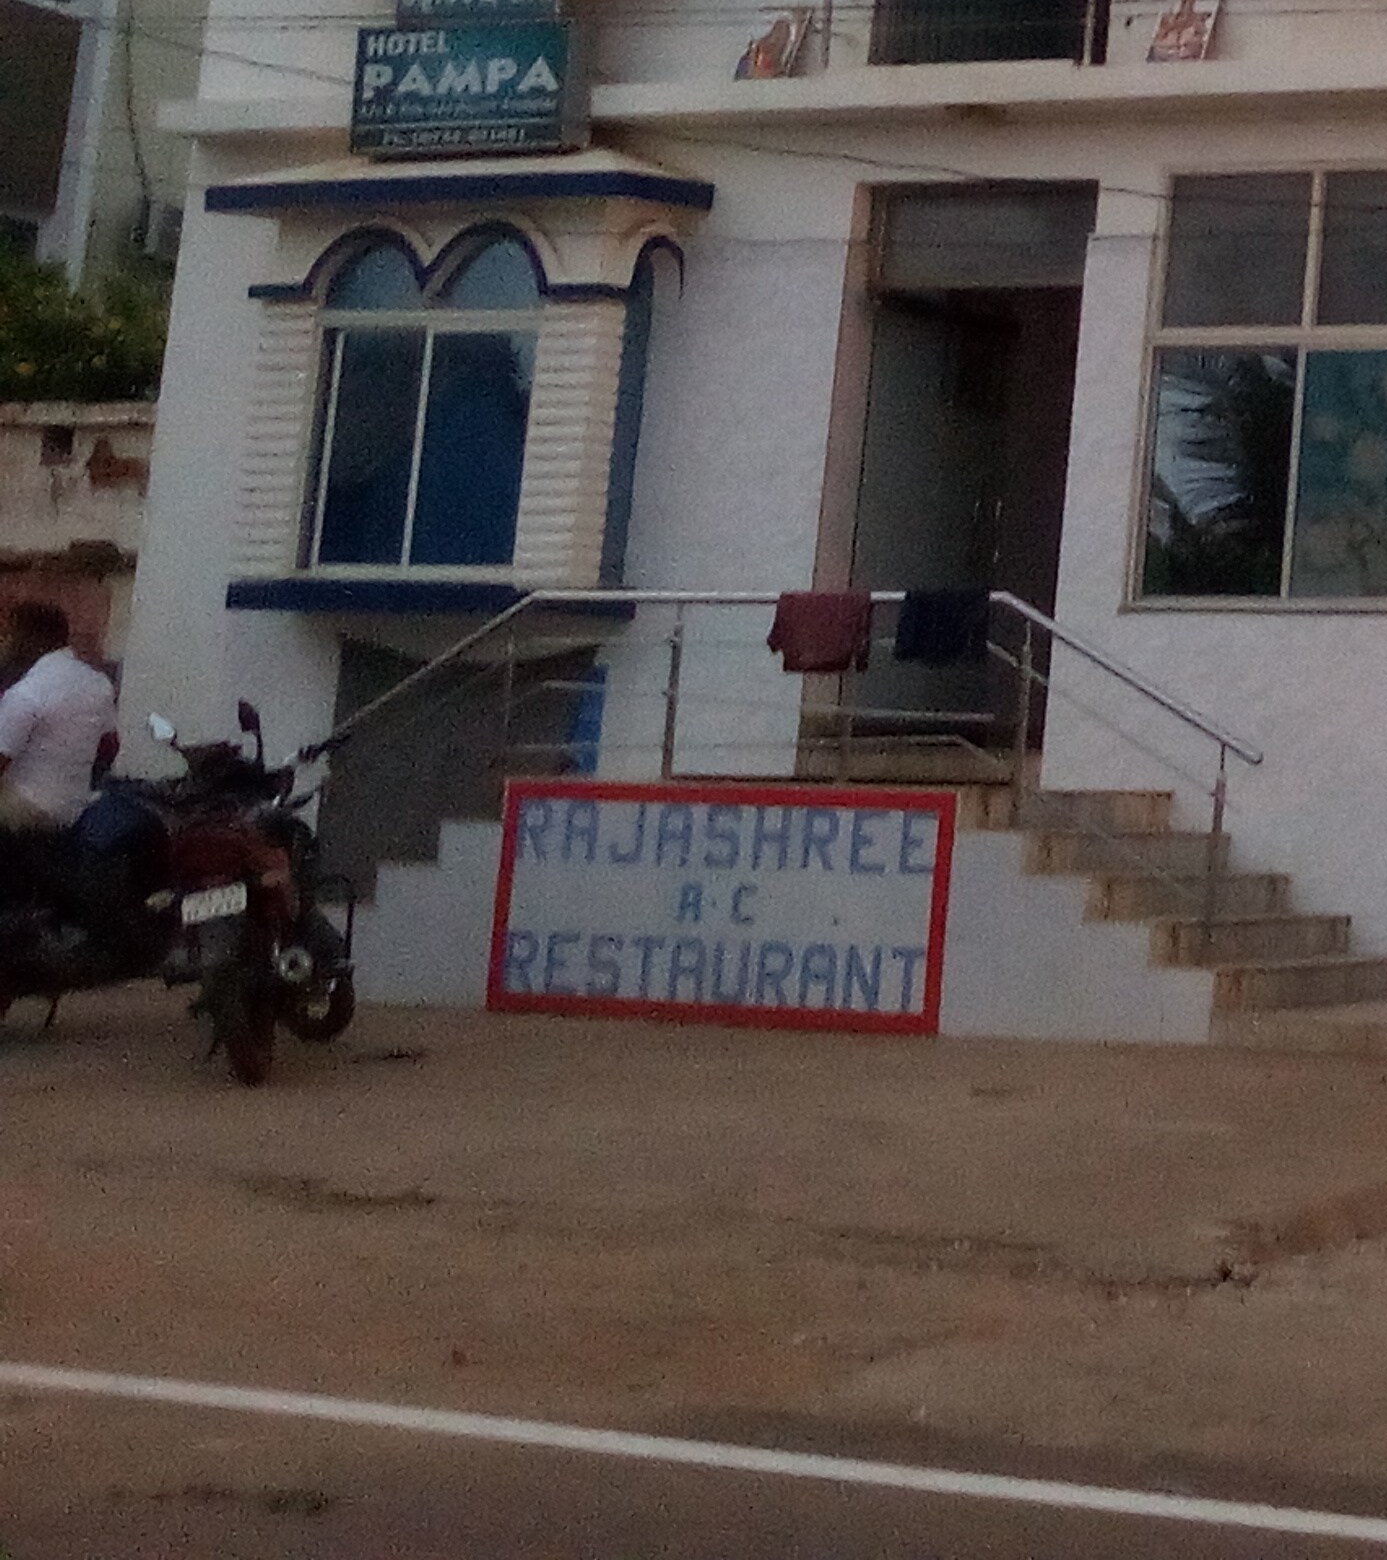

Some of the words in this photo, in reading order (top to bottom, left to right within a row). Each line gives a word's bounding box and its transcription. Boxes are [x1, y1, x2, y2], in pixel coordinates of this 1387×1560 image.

[367, 31, 449, 56] HOTEL
[362, 55, 560, 100] PAMPA
[517, 799, 938, 875] RAJASHREE
[507, 930, 926, 1013] RESTAURANT
